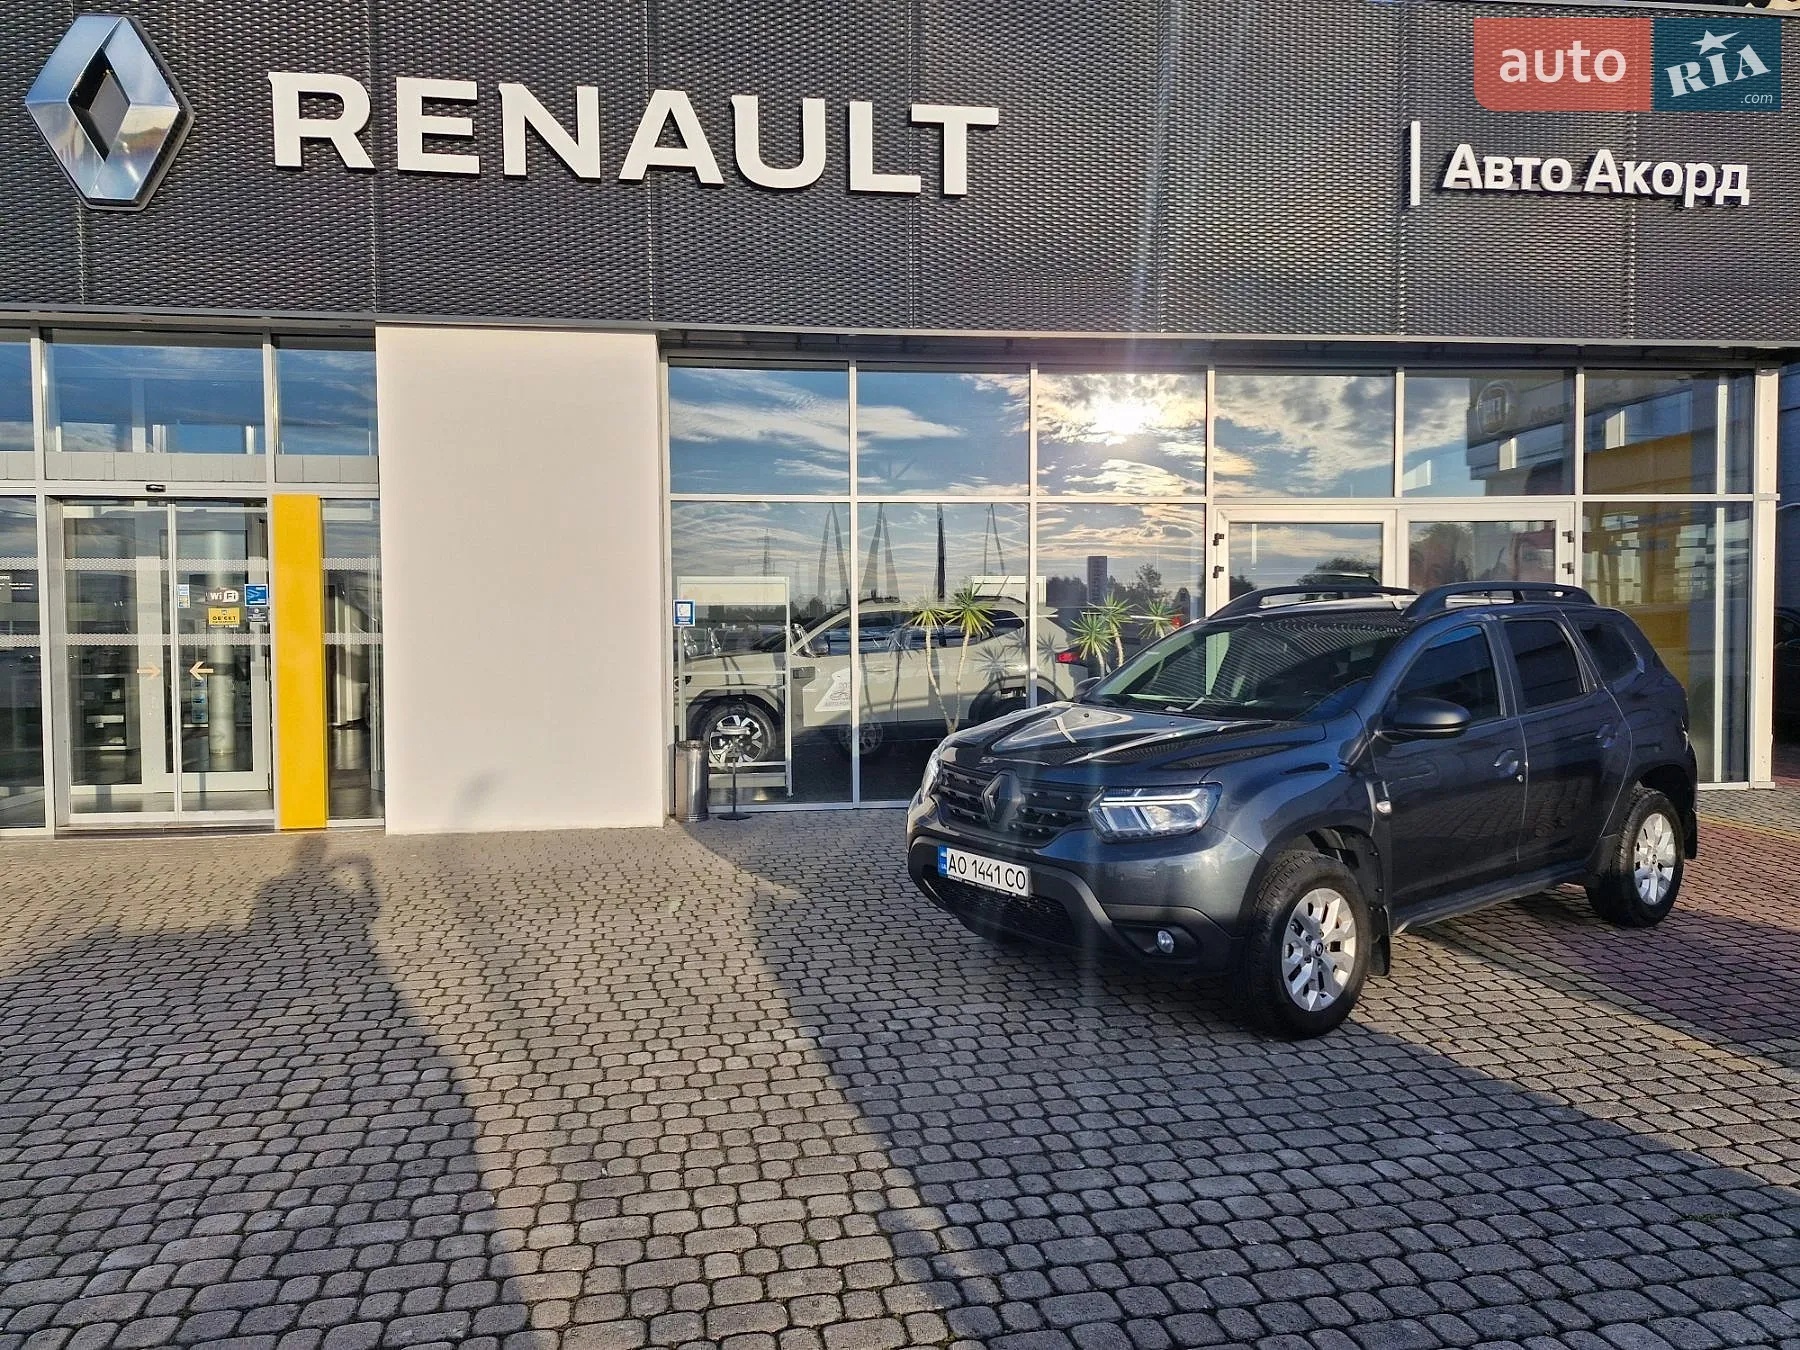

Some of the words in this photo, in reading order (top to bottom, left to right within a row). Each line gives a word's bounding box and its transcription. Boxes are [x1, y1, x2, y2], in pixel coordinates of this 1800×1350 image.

[268, 71, 1000, 196] RENAULT
[1442, 143, 1573, 192] Авто
[1583, 148, 1750, 208] Акорд
[948, 853, 967, 875] AO
[971, 859, 1001, 885] 1441
[1005, 868, 1026, 889] CO
